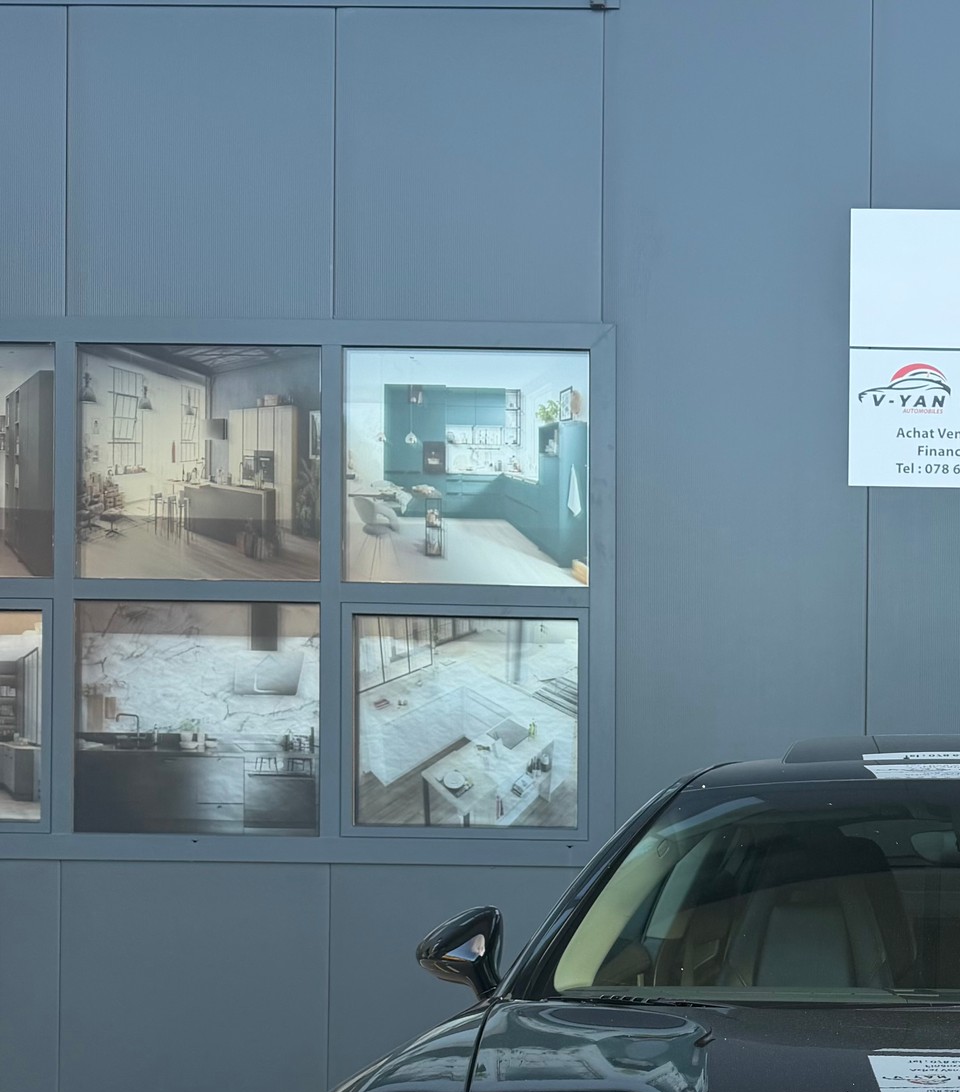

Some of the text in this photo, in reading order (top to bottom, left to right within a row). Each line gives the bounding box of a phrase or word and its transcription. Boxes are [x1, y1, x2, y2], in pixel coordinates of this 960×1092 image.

[872, 394, 946, 408] V-YAN
[896, 427, 935, 439] Achat
[896, 462, 914, 474] Tel
[925, 463, 949, 475] 078
